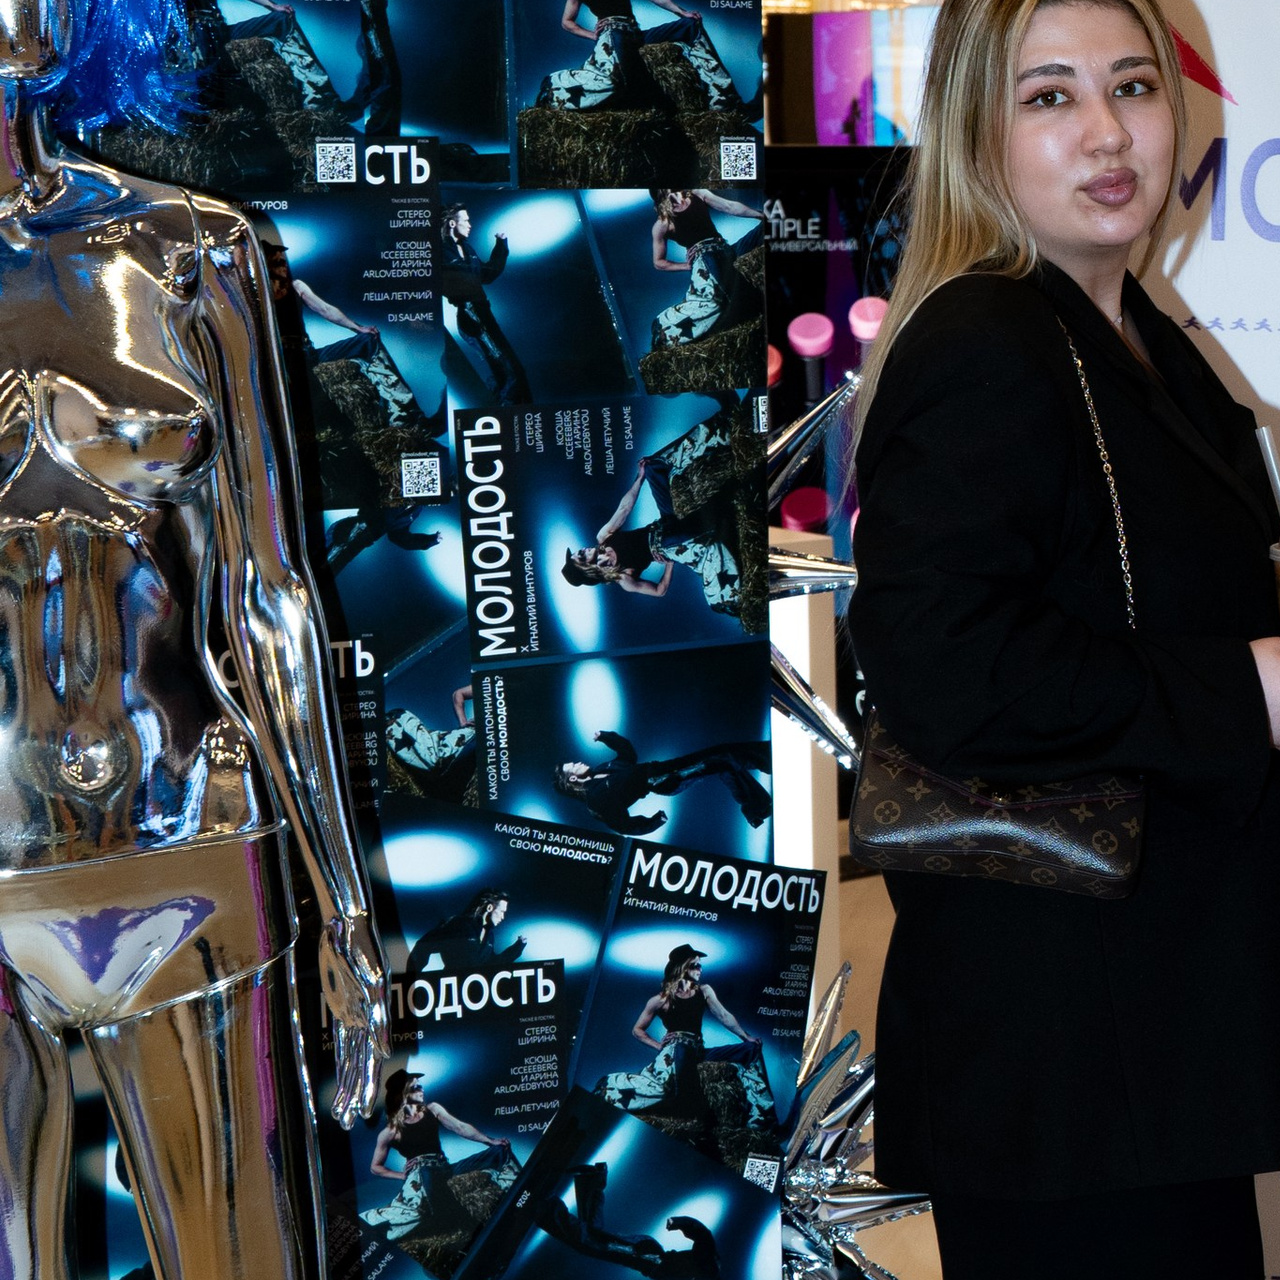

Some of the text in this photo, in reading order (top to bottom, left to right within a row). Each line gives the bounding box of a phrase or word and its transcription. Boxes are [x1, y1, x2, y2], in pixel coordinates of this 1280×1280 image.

[710, 0, 753, 9] DJ SALAME
[390, 219, 431, 228] ШИРИНА
[397, 210, 431, 218] СТЕРЕО
[764, 218, 821, 239] TIPLE
[396, 241, 431, 250] КСЮША
[401, 260, 432, 268] АРИНА
[391, 291, 433, 301] ЛЕТУЧИЙ
[388, 312, 434, 322] DJ SALAME
[525, 413, 533, 446] СТЕРЕО
[602, 407, 612, 447] ЛЕТУЧИЙ
[622, 405, 632, 439] SALAME
[535, 412, 543, 453] ШИРИНА
[463, 415, 517, 657] МОЛОДОСТЬ
[523, 551, 540, 652] ИГНАТИЙ ВИНТУРОВ
[482, 676, 498, 800] КАКОЙ ТЫ ЗАПОМНИШЬ
[495, 675, 510, 782] СВОЮ МОЛОДОСТЬ?
[495, 823, 615, 853] КАКОЙ ТЫ ЗАПОМНИШЬ
[509, 838, 613, 865] СВОЮ МОЛОДОСТЬ?
[628, 848, 820, 913] МОЛОДОСТЬ
[623, 897, 719, 922] ИГНАТИЙ ВИНТУРОВ
[525, 1025, 557, 1036] СТЕРЕО
[518, 1035, 557, 1046] ШИРИНА
[524, 1054, 558, 1065] КСЮША
[529, 1072, 559, 1082] АРИНА
[520, 1100, 560, 1114] ЛЕТУЧИЙ
[528, 1121, 549, 1132] SALA
[515, 1190, 531, 1208] 2026
[370, 1252, 394, 1280] SALAME
